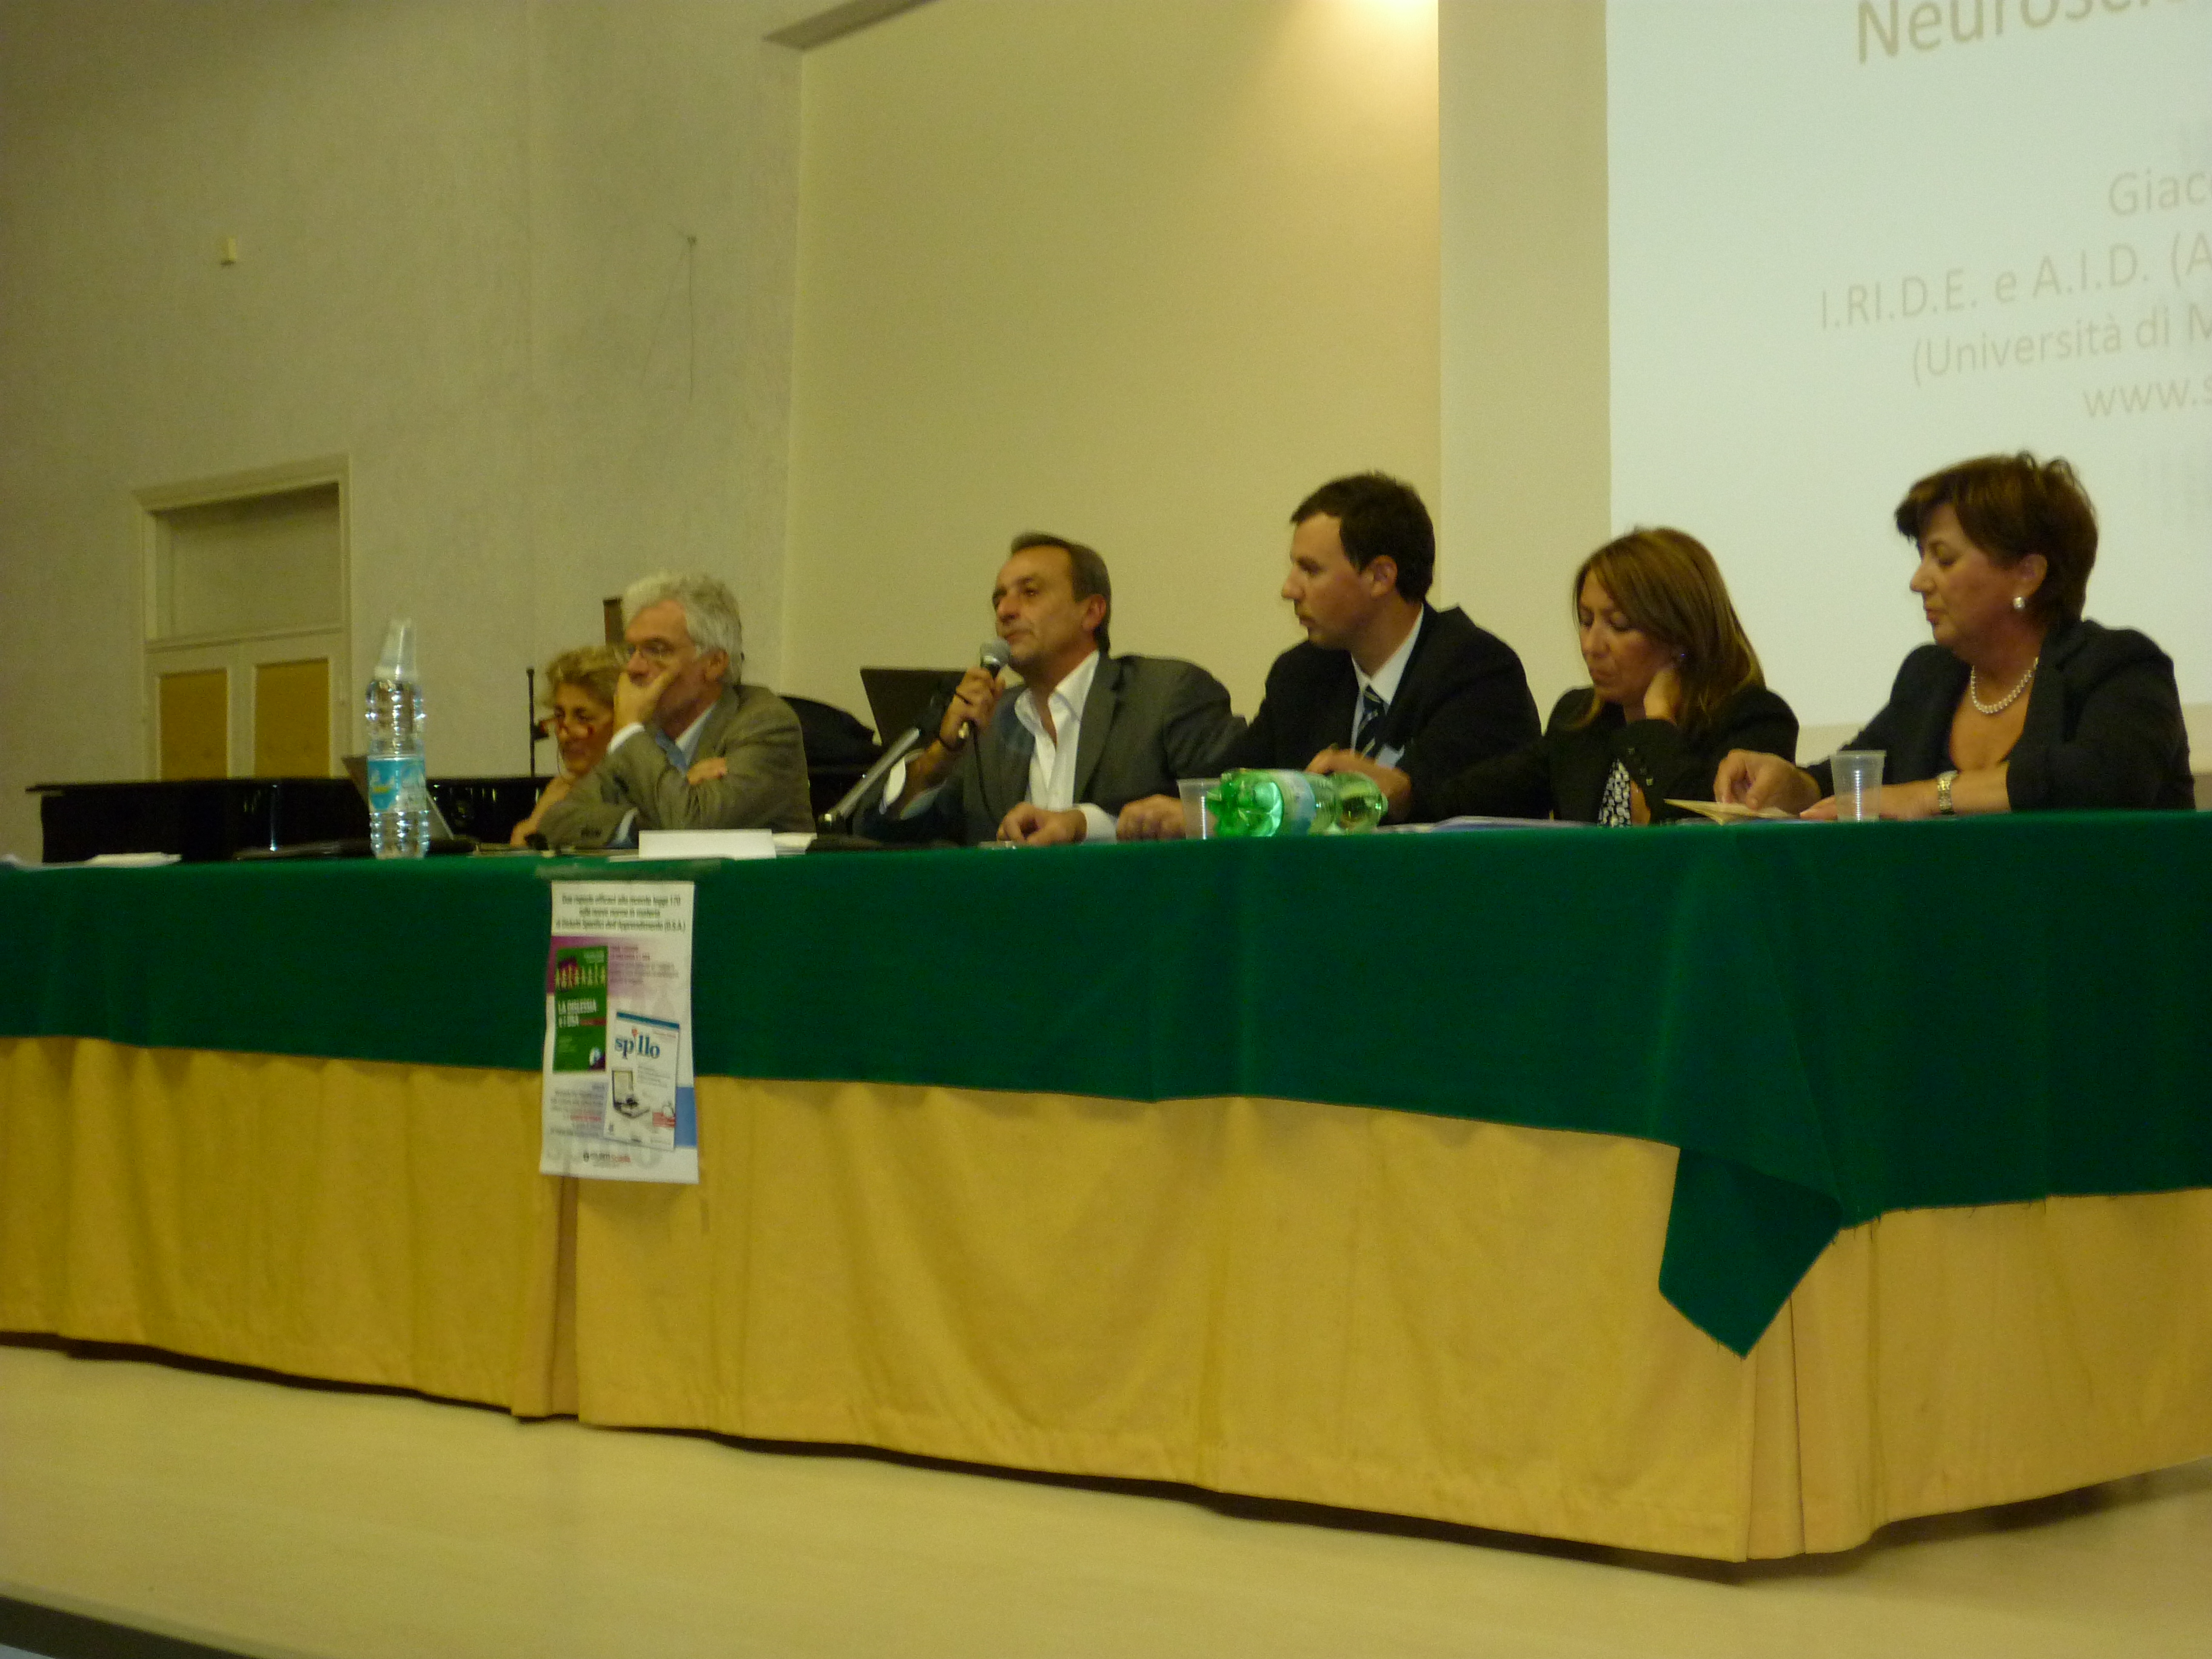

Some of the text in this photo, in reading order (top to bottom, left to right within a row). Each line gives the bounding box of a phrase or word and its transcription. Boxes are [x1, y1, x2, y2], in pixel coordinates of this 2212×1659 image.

[1858, 0, 2188, 64] Neuro
[2108, 166, 2212, 217] Giac
[1821, 267, 1977, 330] I.RI.D.E.
[1995, 269, 2017, 304] e
[2032, 242, 2150, 298] A.I.D.
[1913, 312, 2122, 388] (Università
[2136, 304, 2170, 349] di
